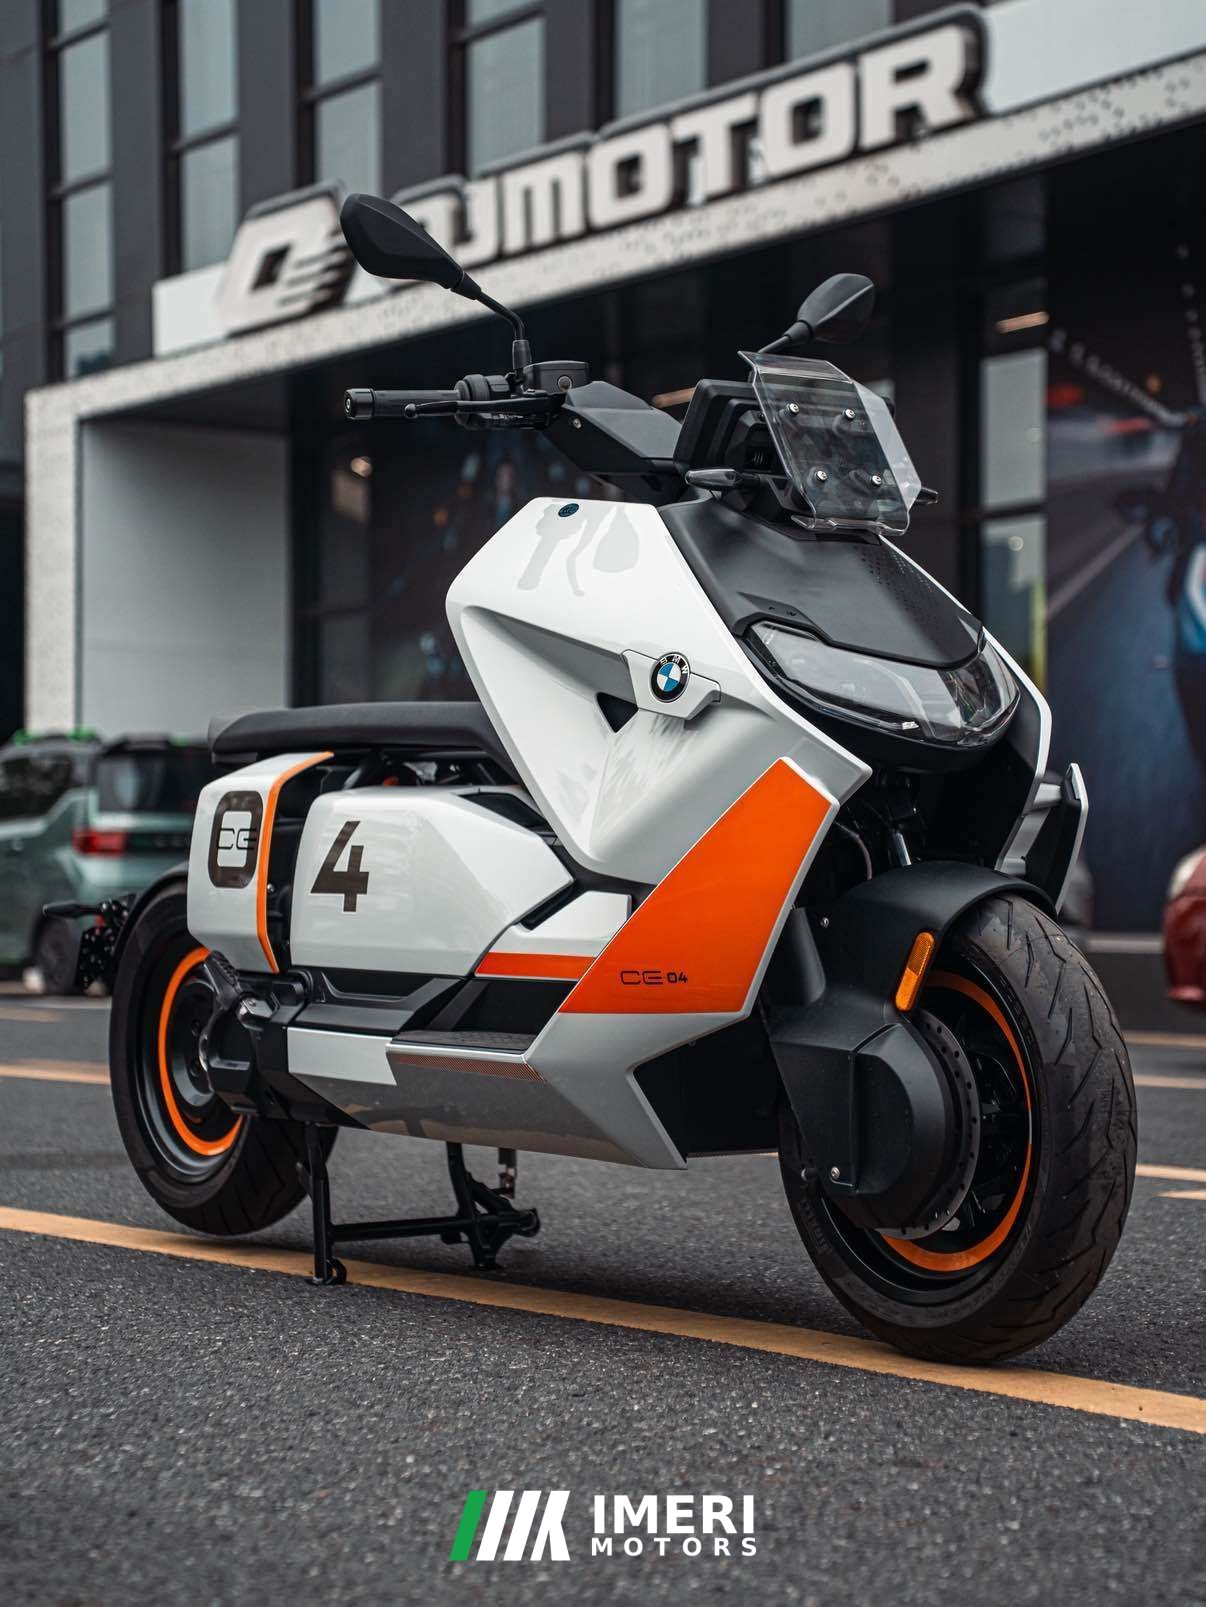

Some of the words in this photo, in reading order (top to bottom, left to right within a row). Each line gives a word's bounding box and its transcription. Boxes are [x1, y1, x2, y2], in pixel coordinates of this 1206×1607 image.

[660, 654, 689, 675] BMW
[620, 970, 664, 985] CE
[666, 971, 688, 984] 04
